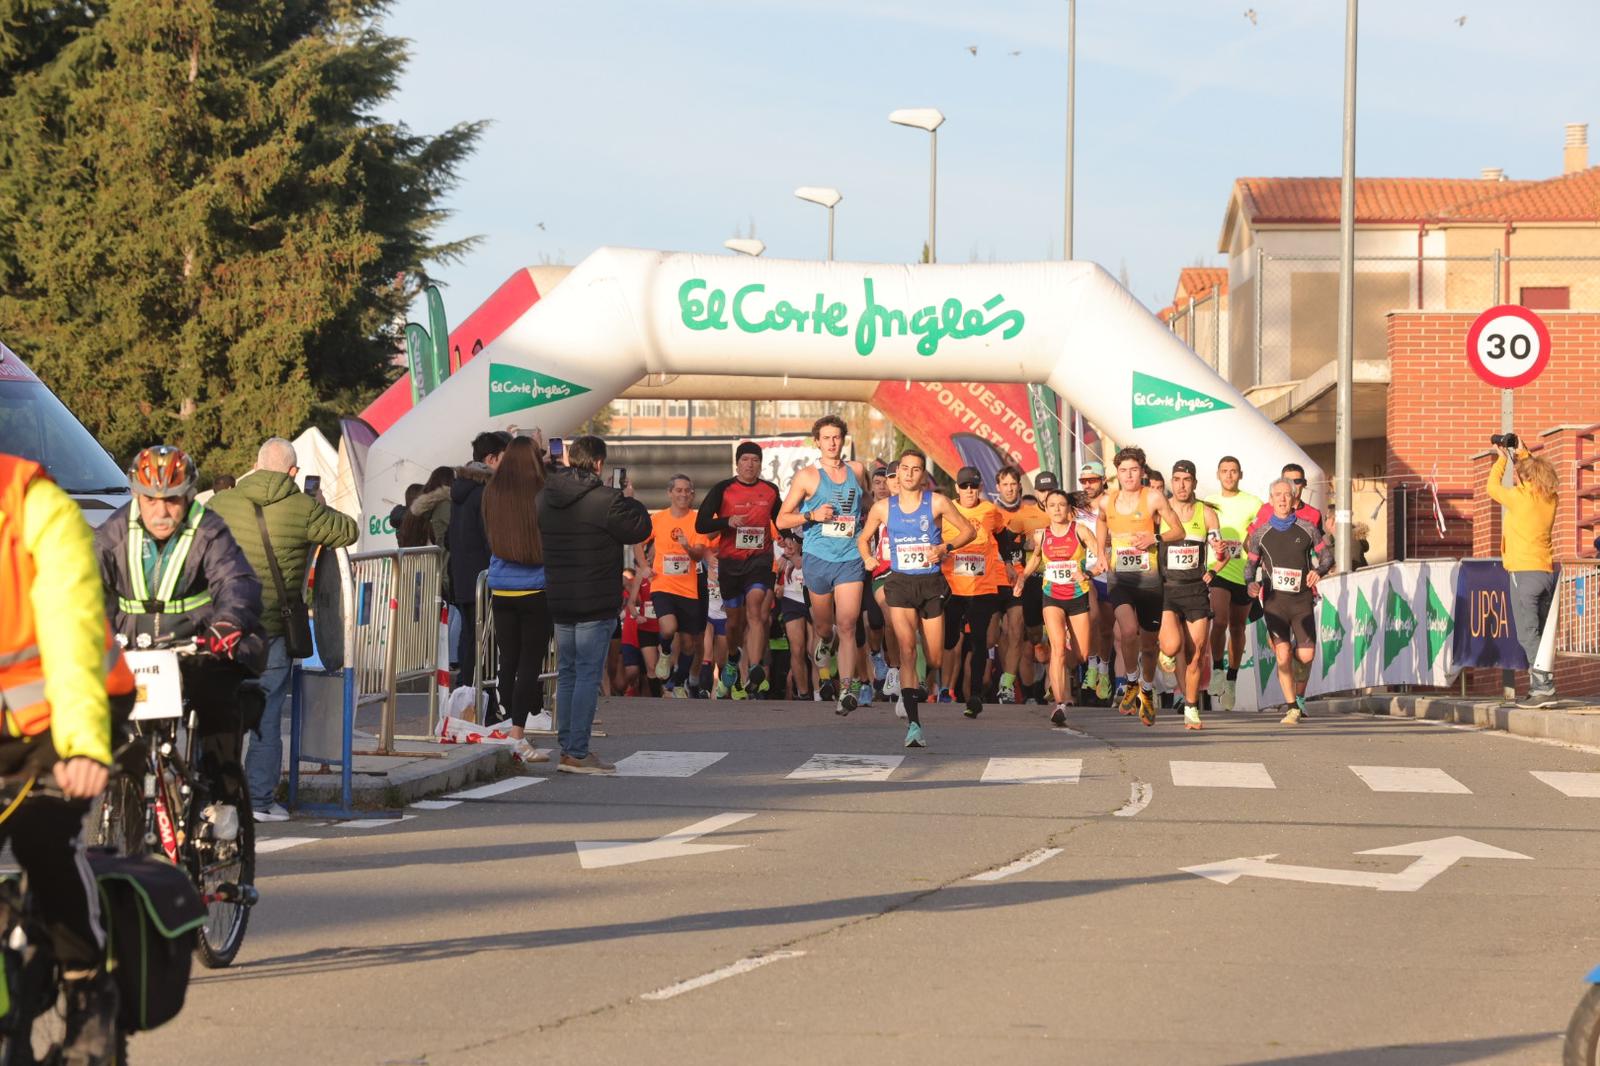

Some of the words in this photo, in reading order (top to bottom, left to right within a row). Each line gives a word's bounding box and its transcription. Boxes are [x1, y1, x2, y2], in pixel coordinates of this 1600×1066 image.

[678, 278, 728, 330] El
[732, 283, 849, 337] Corte
[855, 278, 1025, 356] Inglés
[1486, 333, 1531, 360] 30
[490, 381, 503, 393] El
[503, 381, 531, 393] Corte
[531, 378, 571, 399] Inglés
[1133, 392, 1146, 406] El
[1146, 393, 1175, 407] Corte
[1174, 391, 1215, 412] Inglés
[961, 382, 1039, 453] UESTRO
[369, 514, 382, 536] El
[833, 522, 846, 531] 78
[742, 534, 759, 543] 591
[903, 553, 925, 563] 293
[1122, 555, 1142, 566] 395
[1175, 555, 1194, 564] 123
[674, 562, 680, 570] 5
[965, 563, 976, 571] 16
[1053, 570, 1071, 578] 158
[1277, 576, 1296, 586] 398
[1470, 590, 1509, 638] UPSA
